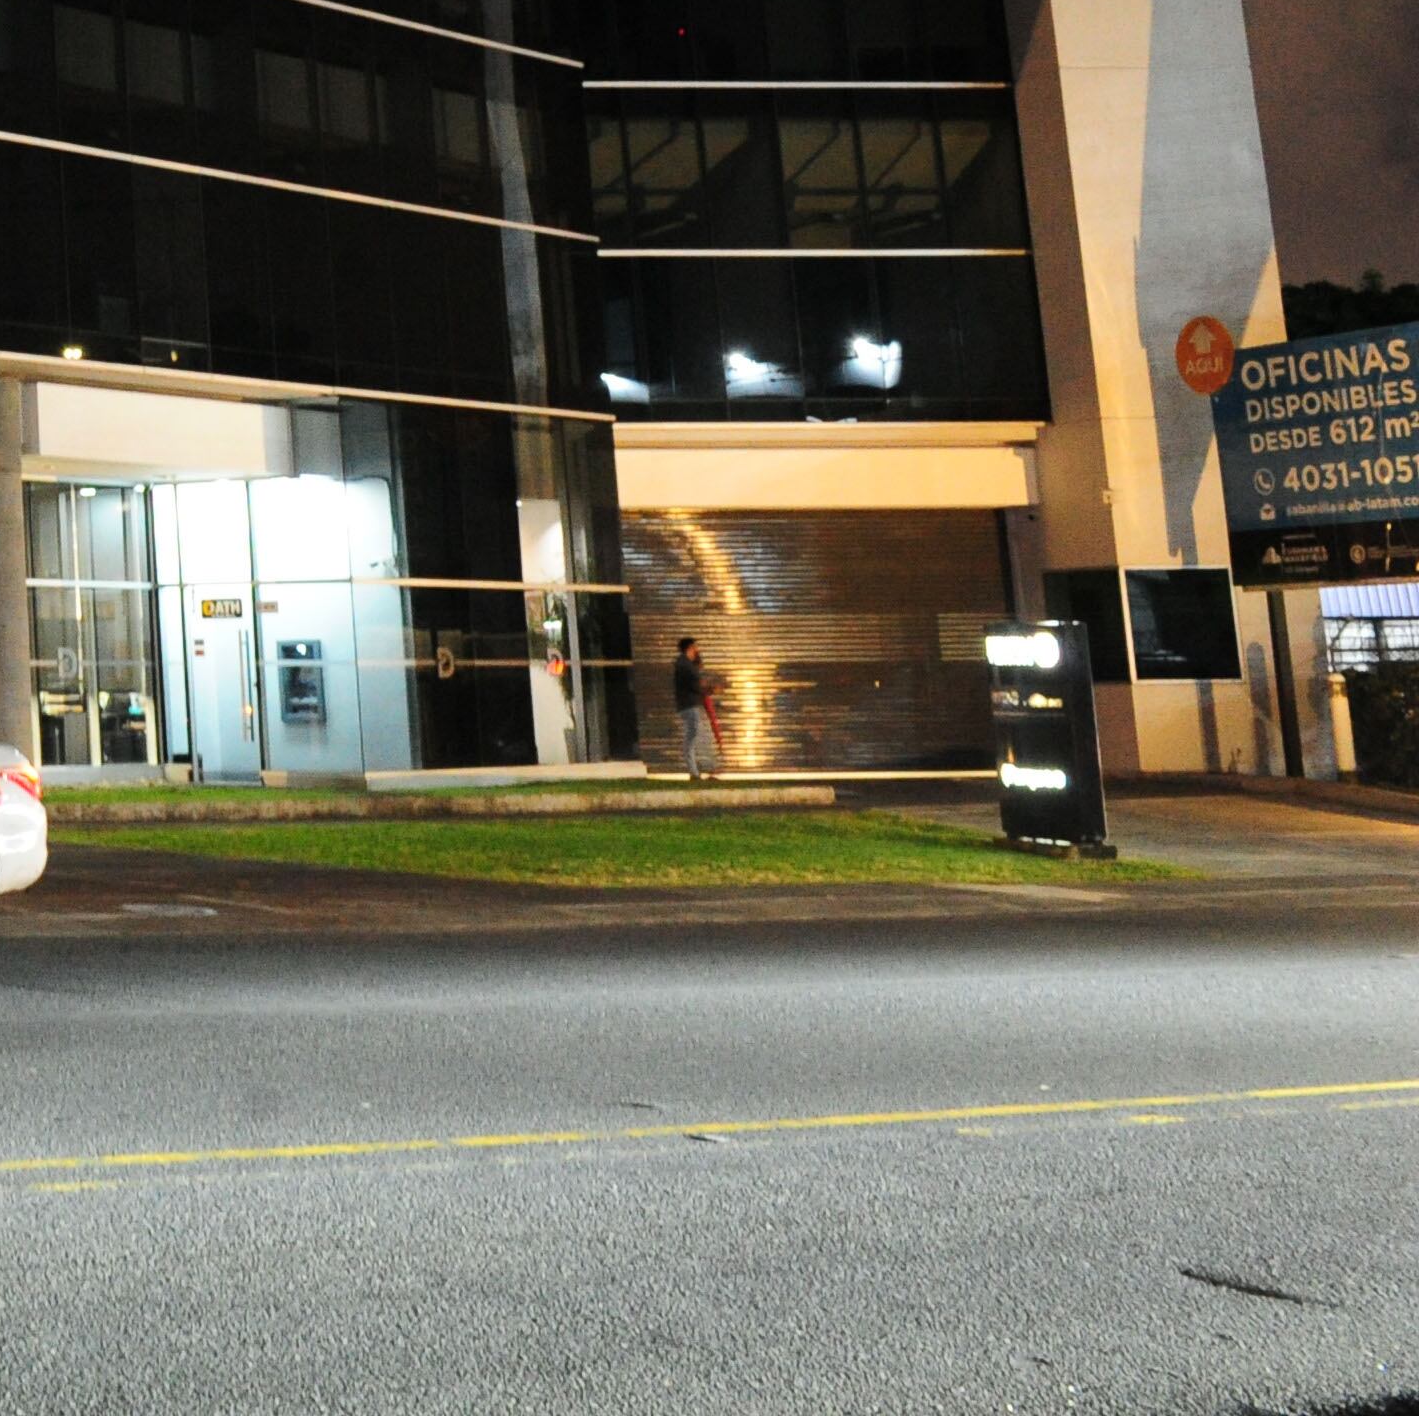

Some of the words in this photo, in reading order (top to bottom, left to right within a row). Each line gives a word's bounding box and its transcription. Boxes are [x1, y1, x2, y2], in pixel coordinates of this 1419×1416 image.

[1240, 338, 1411, 391] OFICINAS
[1245, 379, 1417, 423] DISPONIBLES
[1250, 425, 1323, 454] DESDE
[1329, 414, 1377, 446] 612
